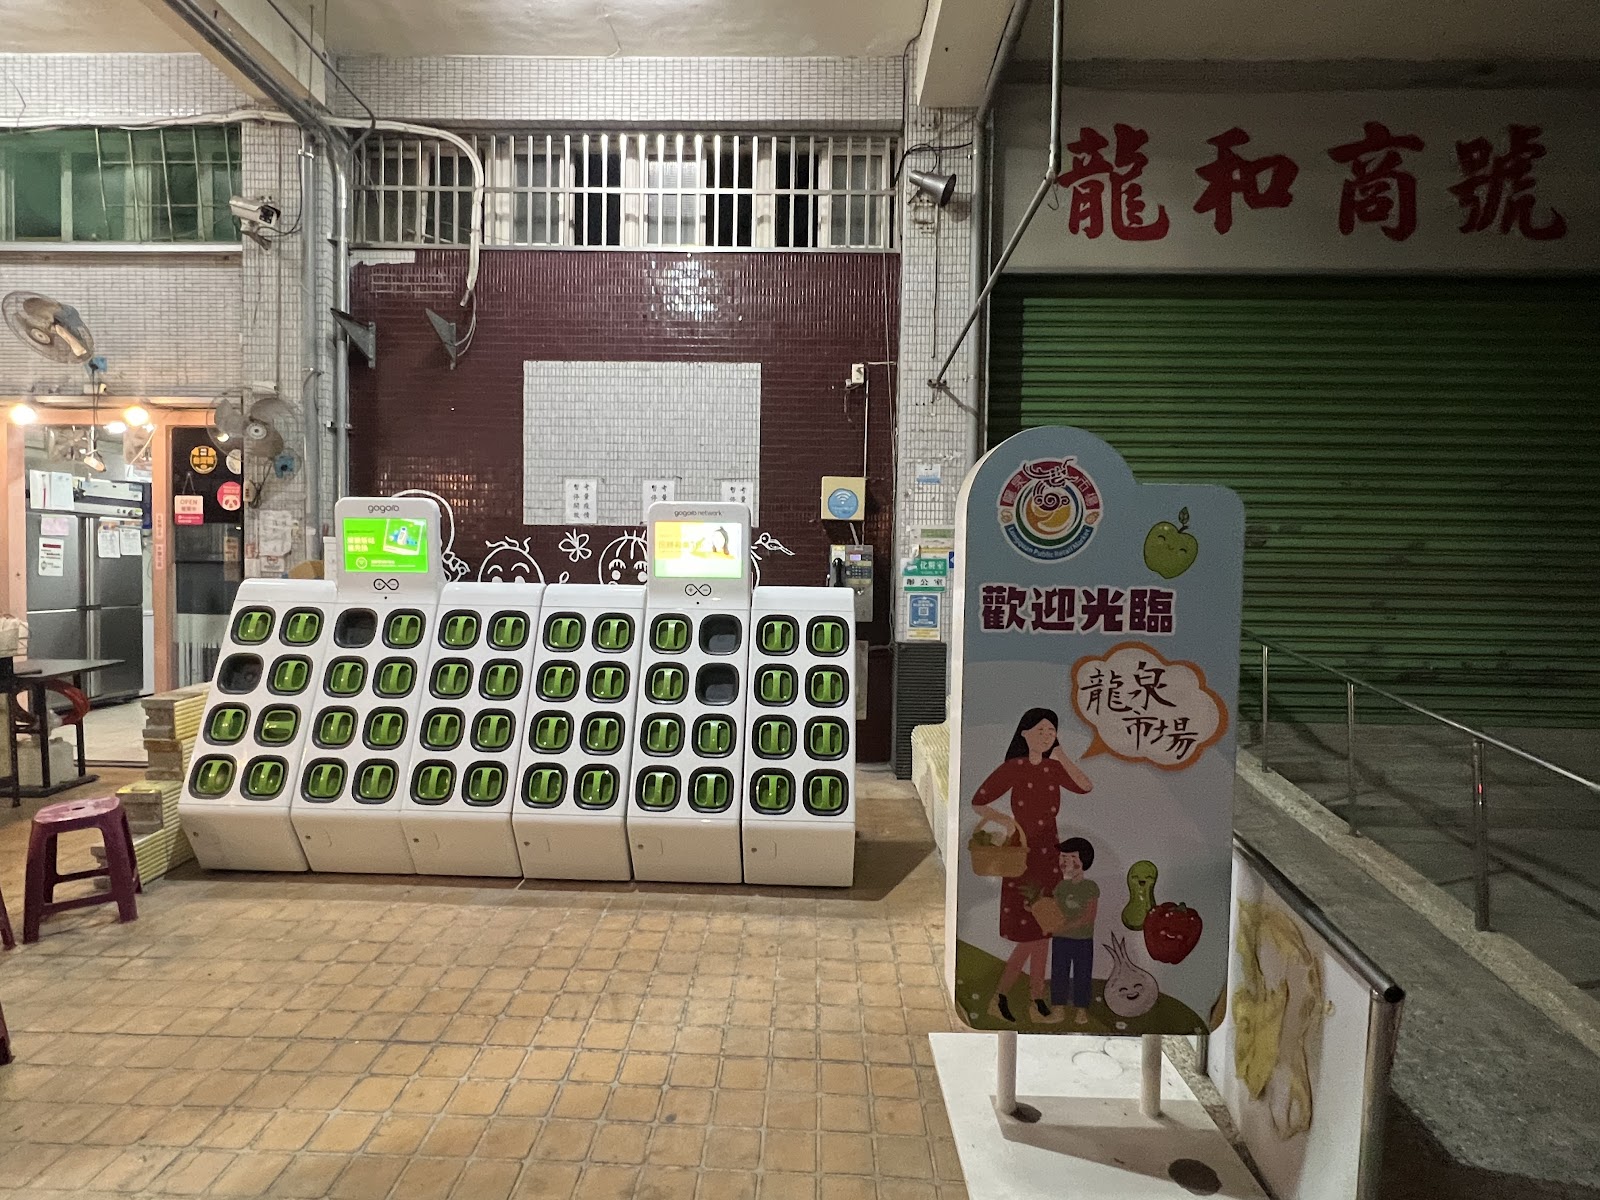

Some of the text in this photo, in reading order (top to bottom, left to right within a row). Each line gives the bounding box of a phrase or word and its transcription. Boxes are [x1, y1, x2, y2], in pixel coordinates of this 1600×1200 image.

[1057, 121, 1569, 242] 龍和商號
[367, 505, 400, 513] gogoro
[981, 585, 1174, 633] 歡迎光臨
[1080, 661, 1177, 714] 龍泉
[1122, 712, 1199, 760] 市場
